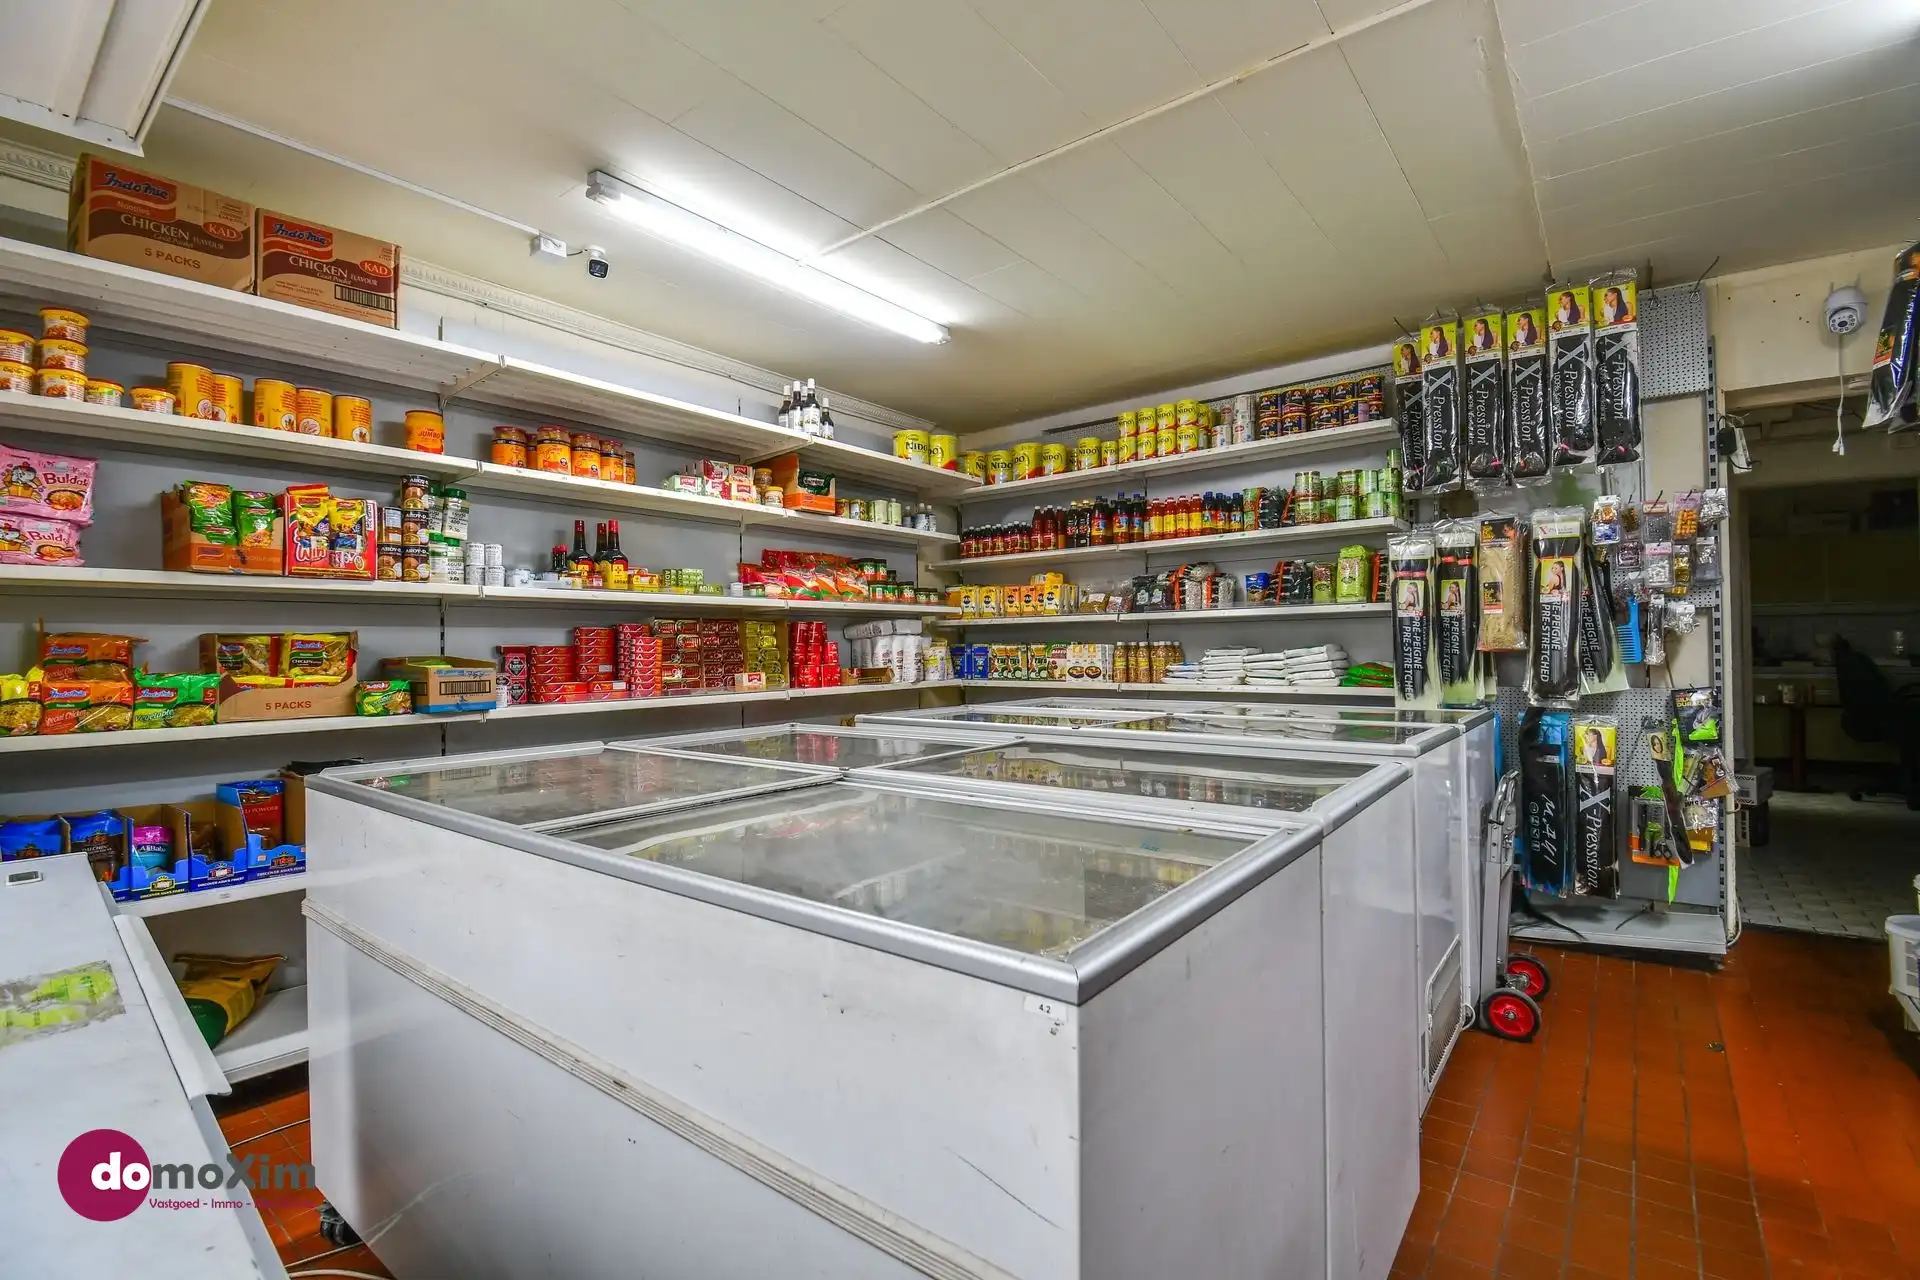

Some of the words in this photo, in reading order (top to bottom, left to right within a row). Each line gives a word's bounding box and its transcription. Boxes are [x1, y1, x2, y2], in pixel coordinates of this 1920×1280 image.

[120, 214, 190, 240] CHICKEN
[208, 224, 237, 238] KAD
[145, 248, 152, 257] 5
[156, 249, 201, 269] PACKS
[289, 256, 348, 278] CHICKEN
[350, 274, 378, 286] FLAVOUR
[364, 262, 388, 274] KAD
[1558, 342, 1587, 427] X-Pression
[1605, 336, 1631, 419] X-Pression
[1429, 370, 1453, 450] X-Pression
[1470, 364, 1496, 445] X-Pression
[1515, 360, 1541, 442] X-Pression
[418, 431, 440, 439] JUMBO
[43, 473, 89, 487] Buldak
[1442, 616, 1452, 682] RE-STRETCHED
[1541, 604, 1552, 682] PRE-STRETCHED
[1403, 626, 1414, 700] PRE-STRETCHED
[206, 690, 213, 698] 5
[275, 701, 311, 709] PACKS
